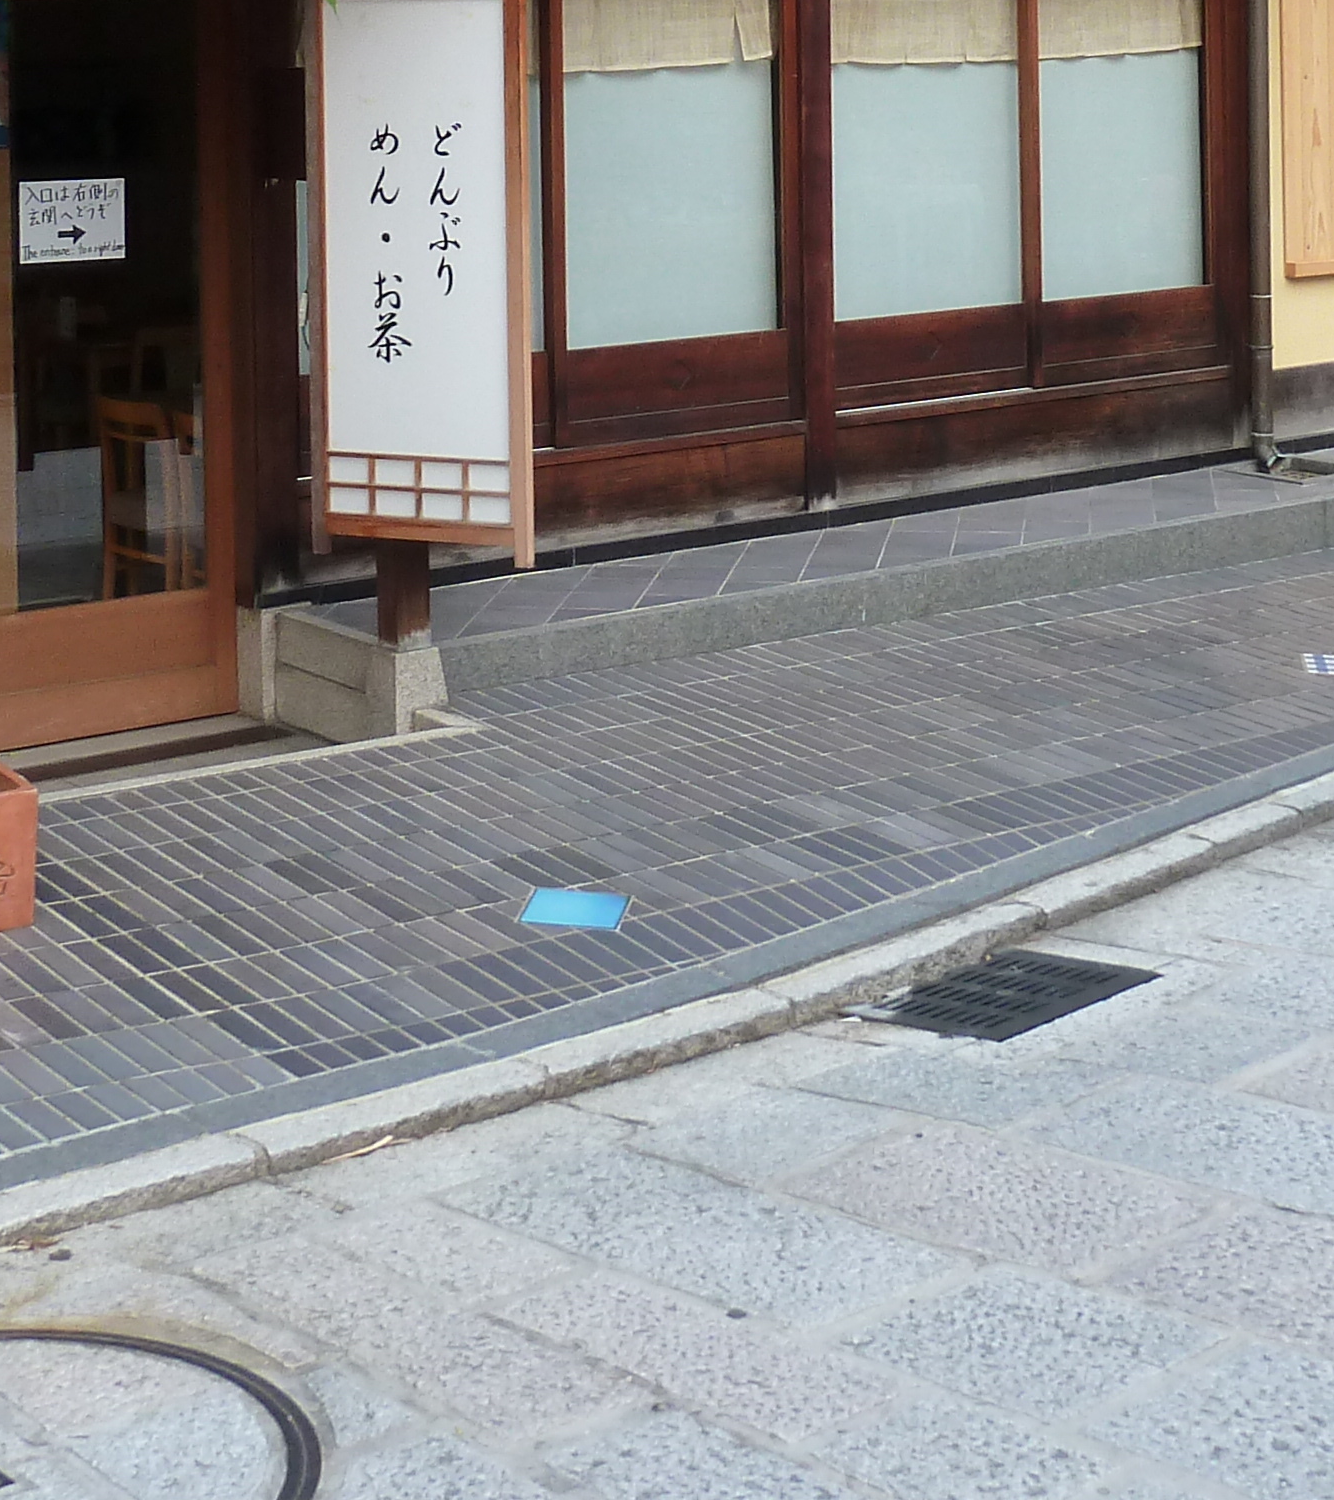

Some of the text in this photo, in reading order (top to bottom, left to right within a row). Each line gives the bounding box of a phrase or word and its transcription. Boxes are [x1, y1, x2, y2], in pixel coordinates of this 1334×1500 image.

[24, 182, 120, 205] 入口は右側の
[27, 202, 112, 227] 玄関へどうぞ
[427, 122, 462, 298] どんぶり
[22, 244, 38, 261] The
[367, 124, 412, 364] めん・お茶
